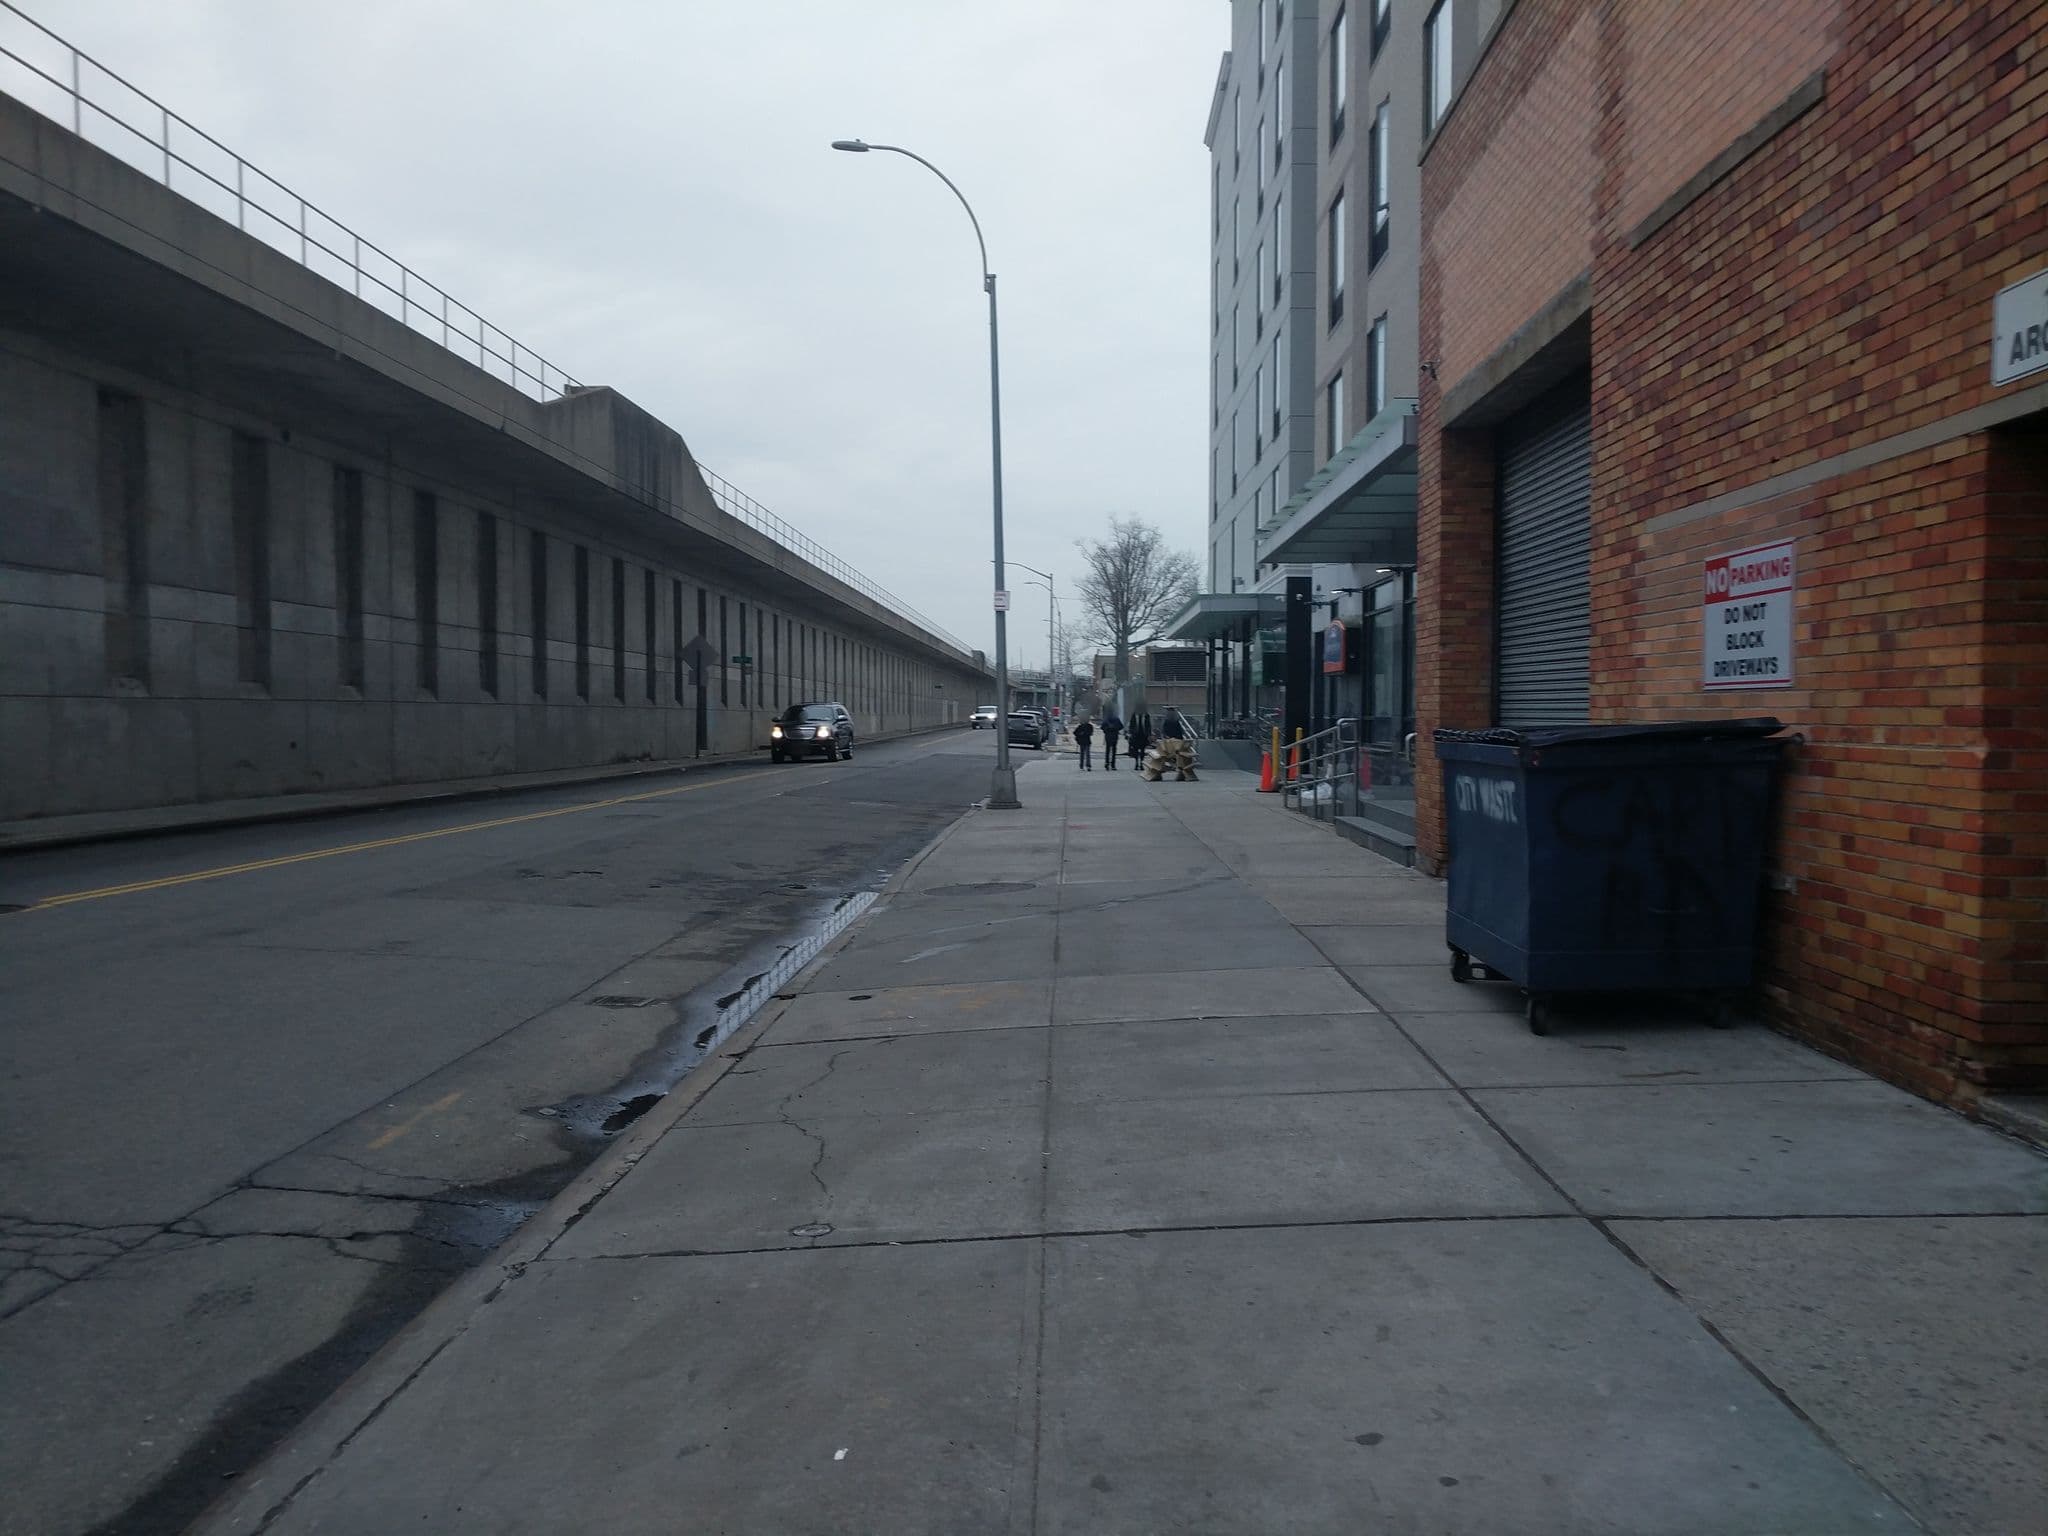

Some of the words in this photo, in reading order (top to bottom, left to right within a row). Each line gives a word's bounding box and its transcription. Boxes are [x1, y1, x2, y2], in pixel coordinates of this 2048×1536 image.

[1705, 566, 1728, 594] NO
[1730, 556, 1791, 587] PARKING
[1724, 607, 1740, 624] DO
[1743, 602, 1767, 622] NOT
[1725, 630, 1765, 650] BLOCK
[1713, 656, 1779, 677] DRIVEWAYS
